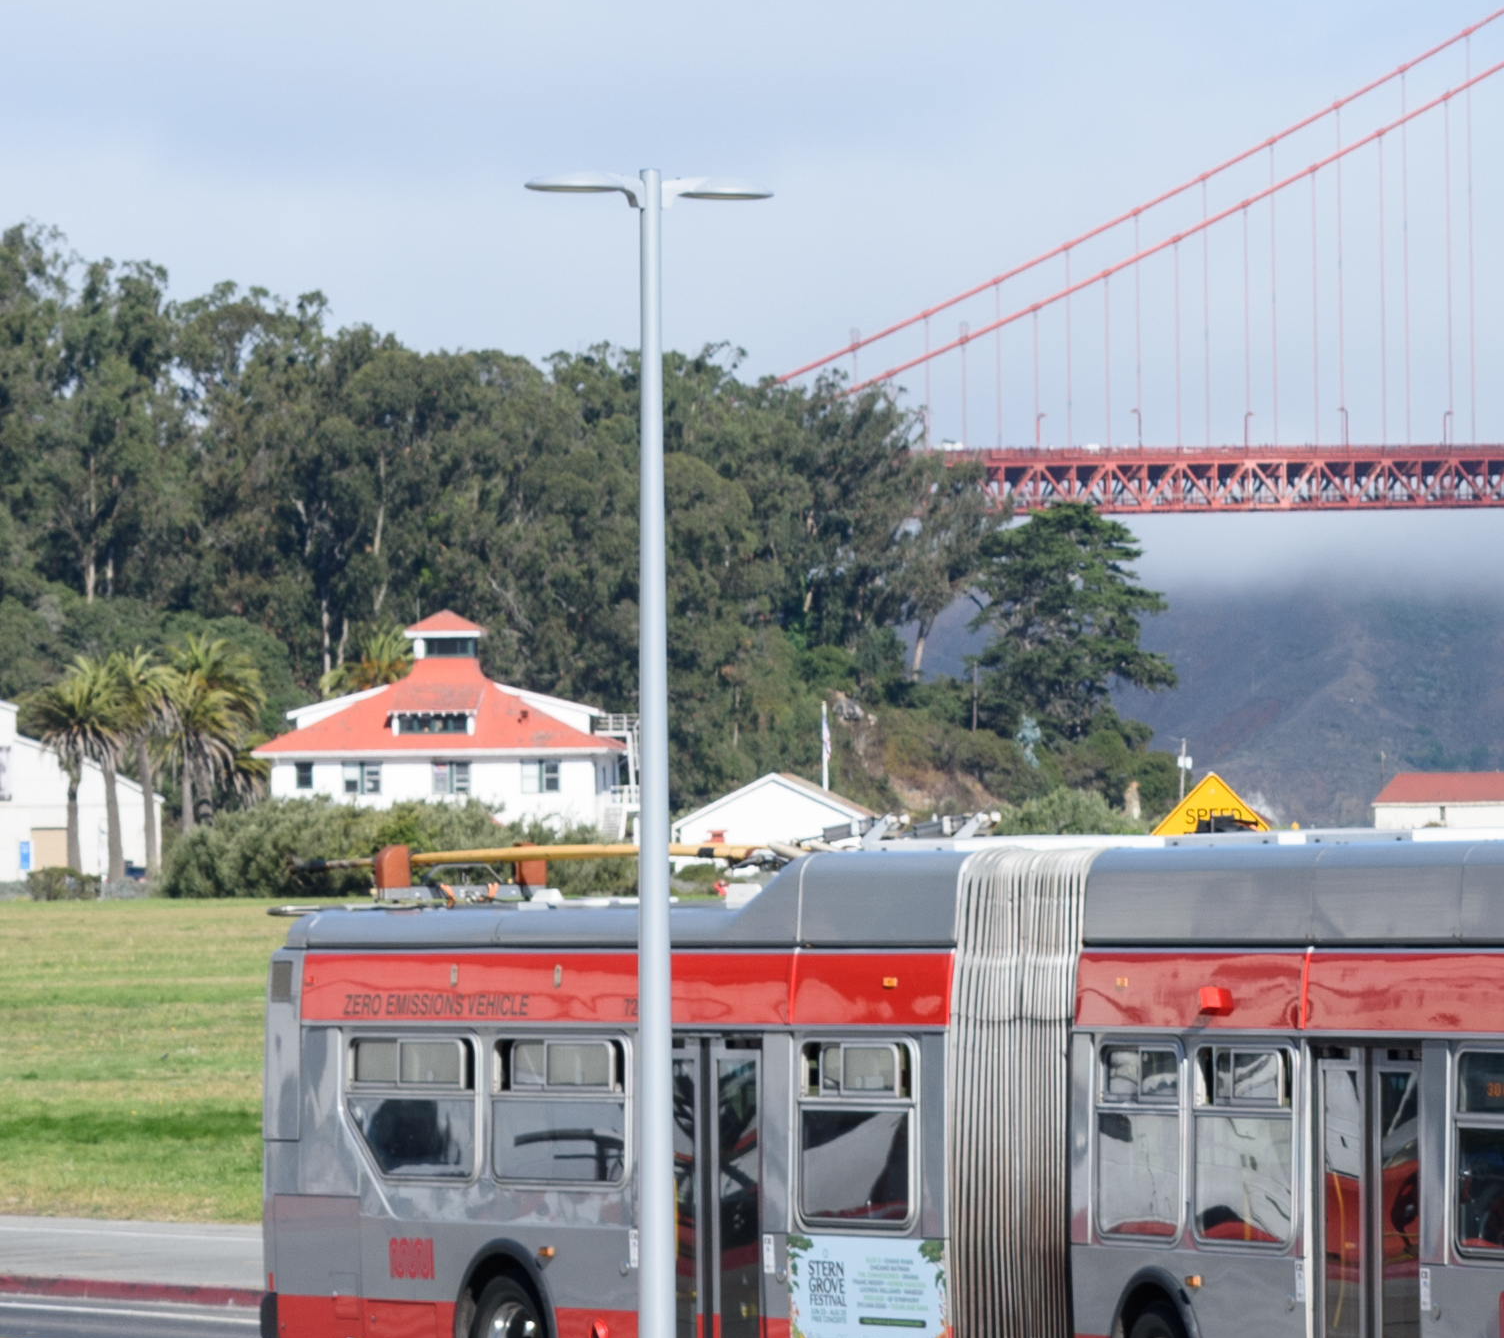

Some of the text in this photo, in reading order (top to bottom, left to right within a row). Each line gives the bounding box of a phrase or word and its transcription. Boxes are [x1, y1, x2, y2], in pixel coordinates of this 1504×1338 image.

[343, 993, 530, 1017] ZERO EMISSIONS VEHICLE
[1486, 1082, 1501, 1098] 30
[808, 1260, 845, 1278] STERN
[808, 1277, 846, 1294] GROVE
[809, 1294, 847, 1307] FESTIVAL
